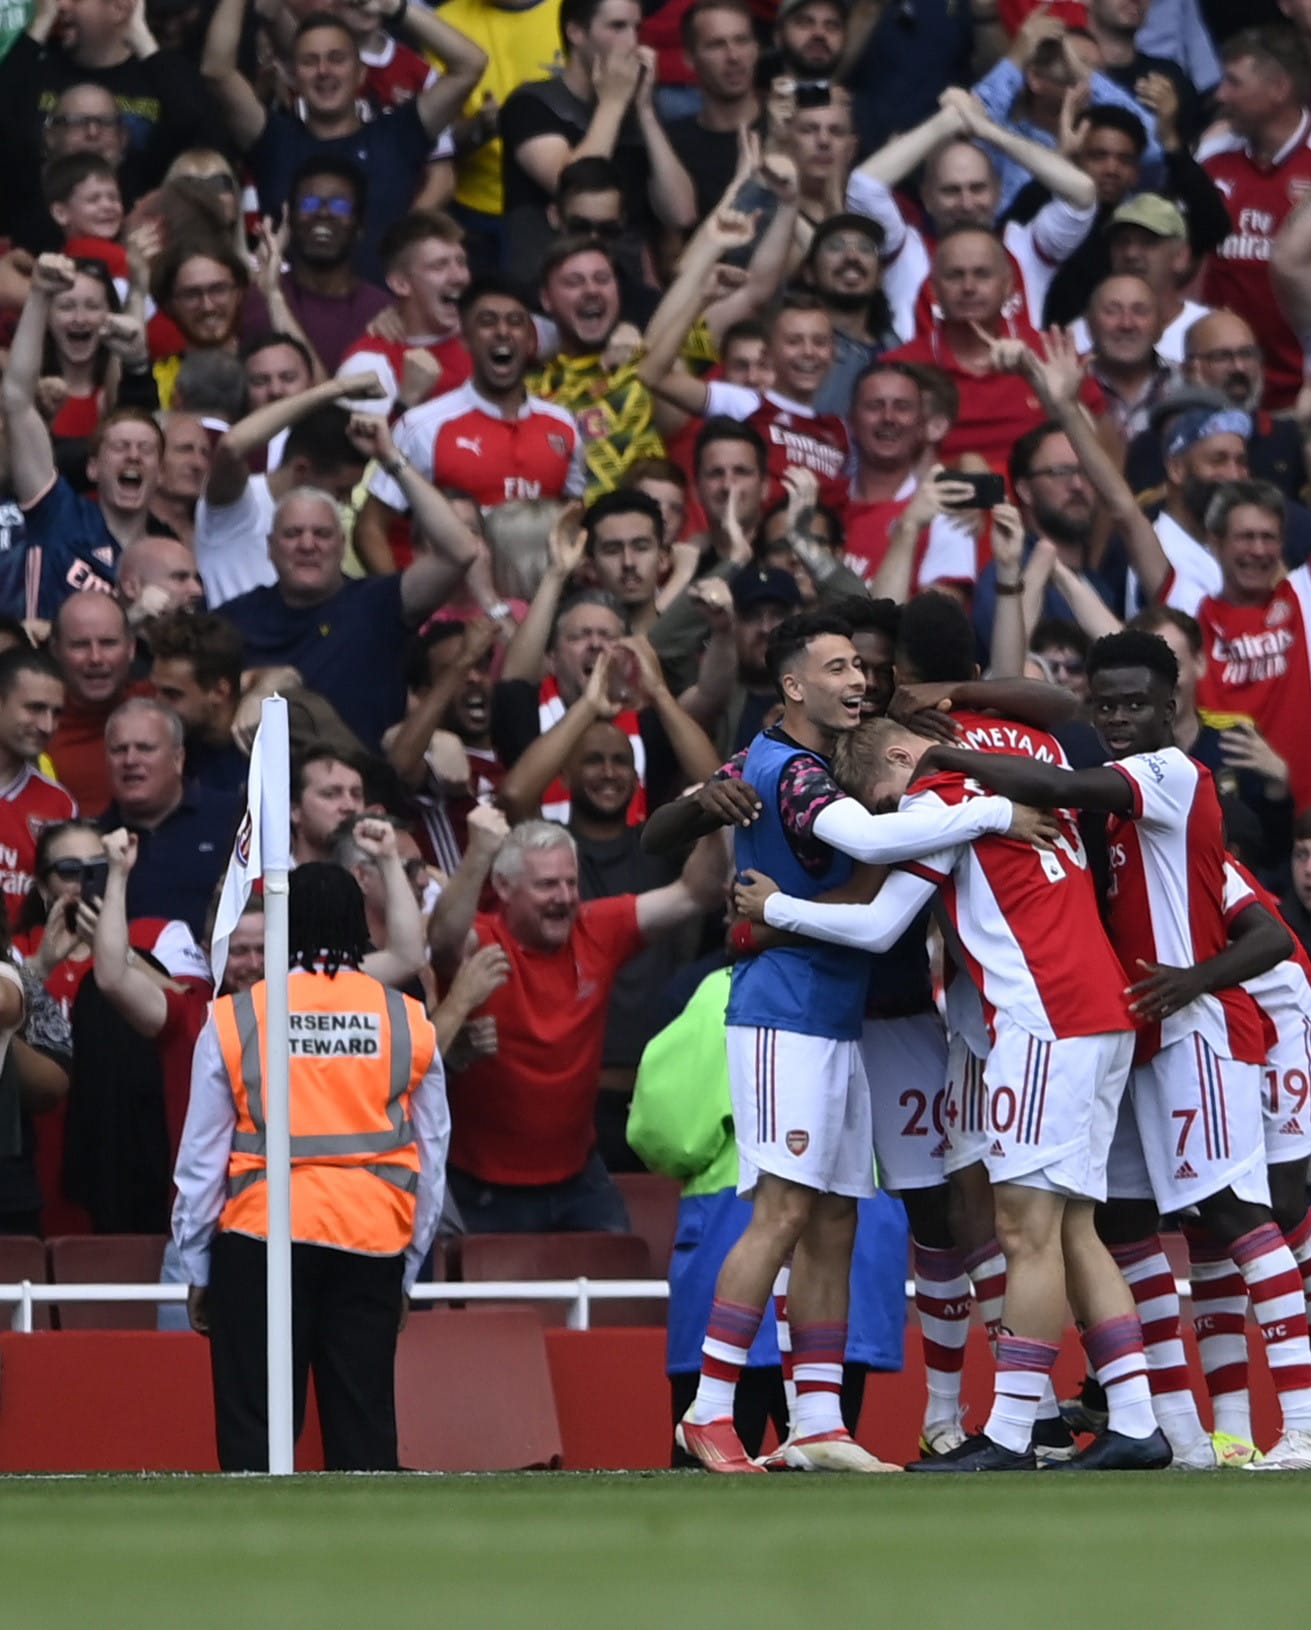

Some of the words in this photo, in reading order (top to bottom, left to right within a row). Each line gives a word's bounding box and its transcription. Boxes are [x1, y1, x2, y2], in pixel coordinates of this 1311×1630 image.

[289, 1014, 377, 1031] RSENAL
[288, 1038, 378, 1055] TEWARD
[1264, 1068, 1309, 1115] 19
[1171, 1108, 1199, 1158] 7
